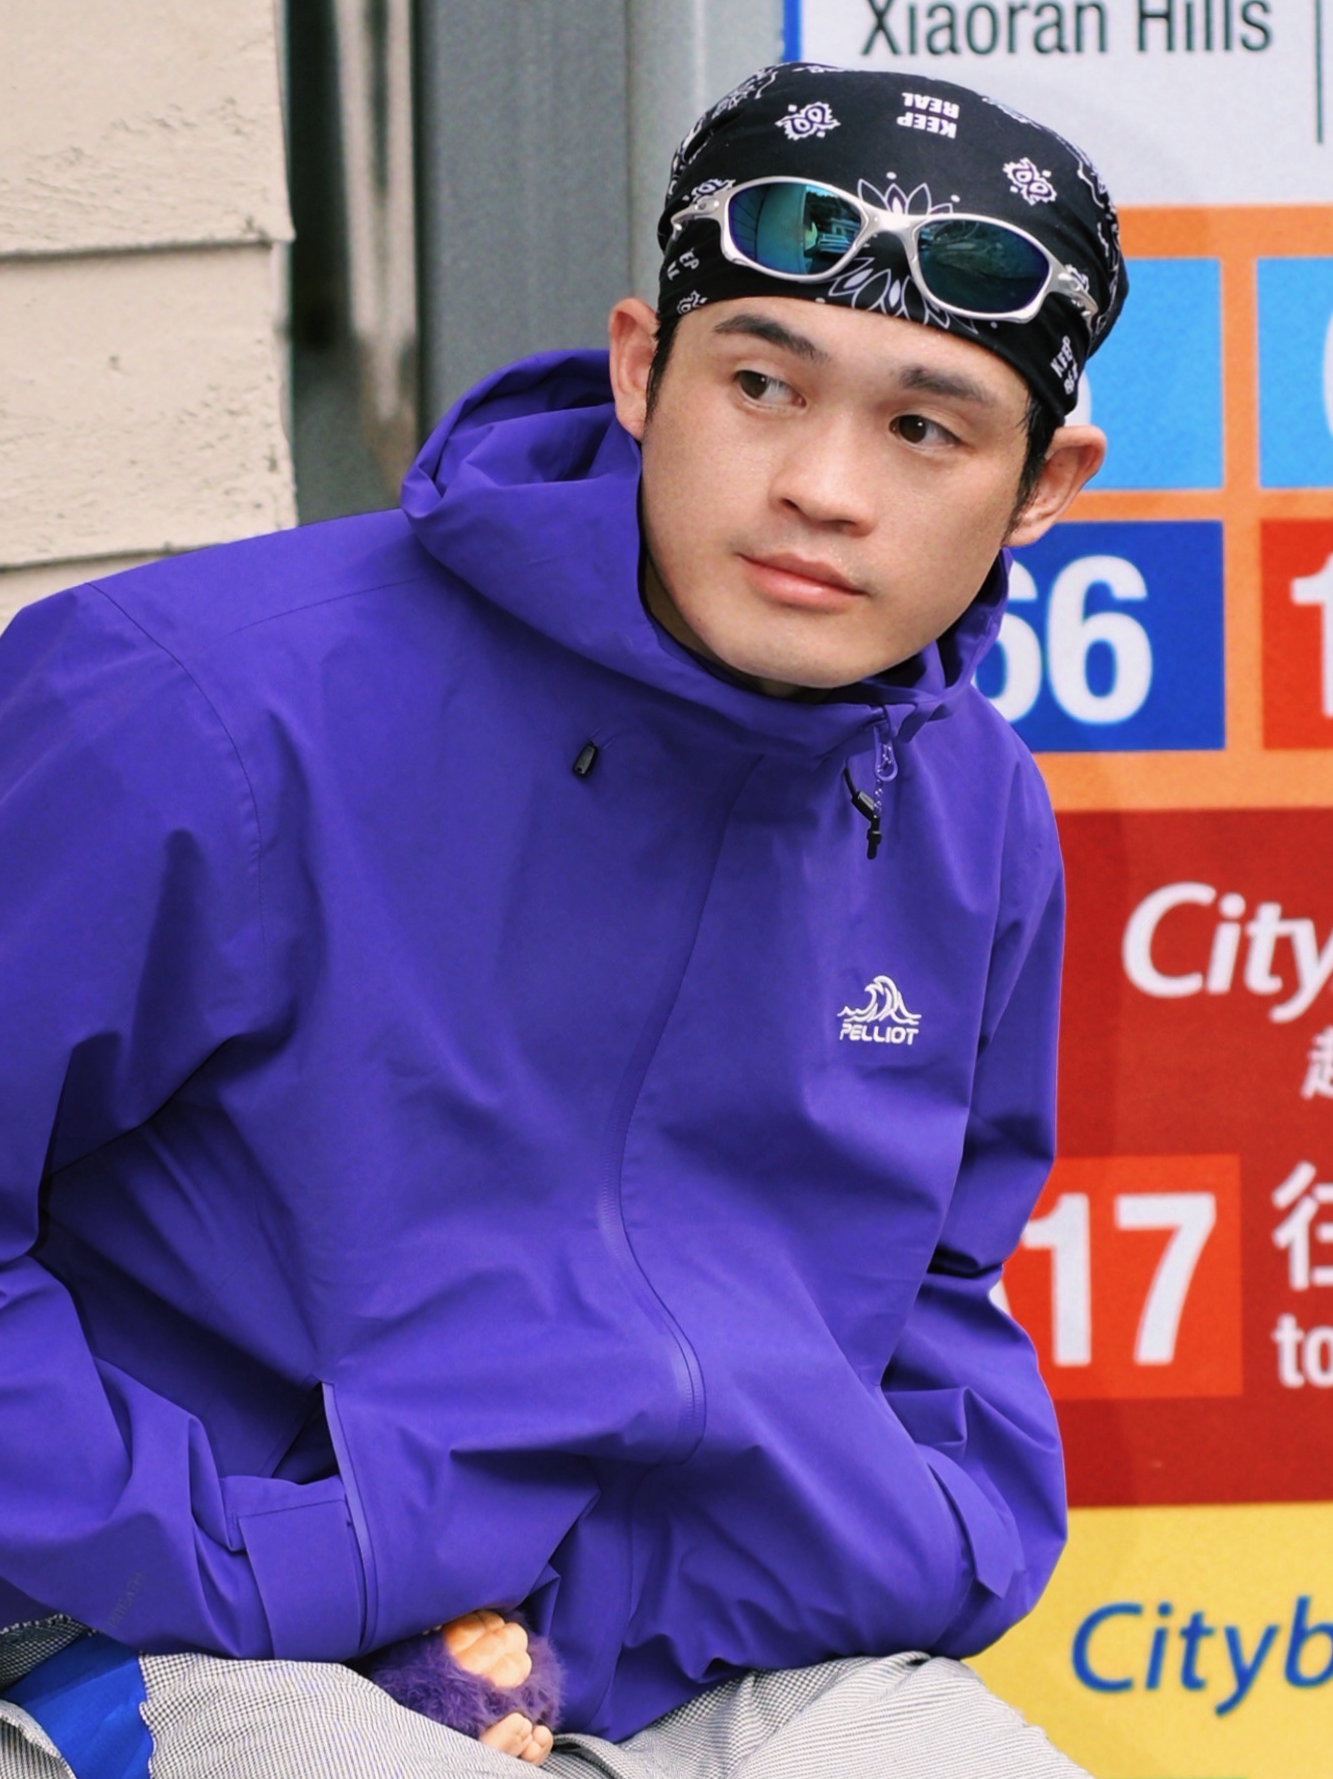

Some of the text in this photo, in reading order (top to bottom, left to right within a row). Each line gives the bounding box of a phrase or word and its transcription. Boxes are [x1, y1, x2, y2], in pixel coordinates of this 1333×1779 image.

[901, 92, 961, 120] REAL
[896, 111, 958, 140] KEEP
[839, 1023, 919, 1045] PELLIOT
[988, 1191, 1217, 1367] 17
